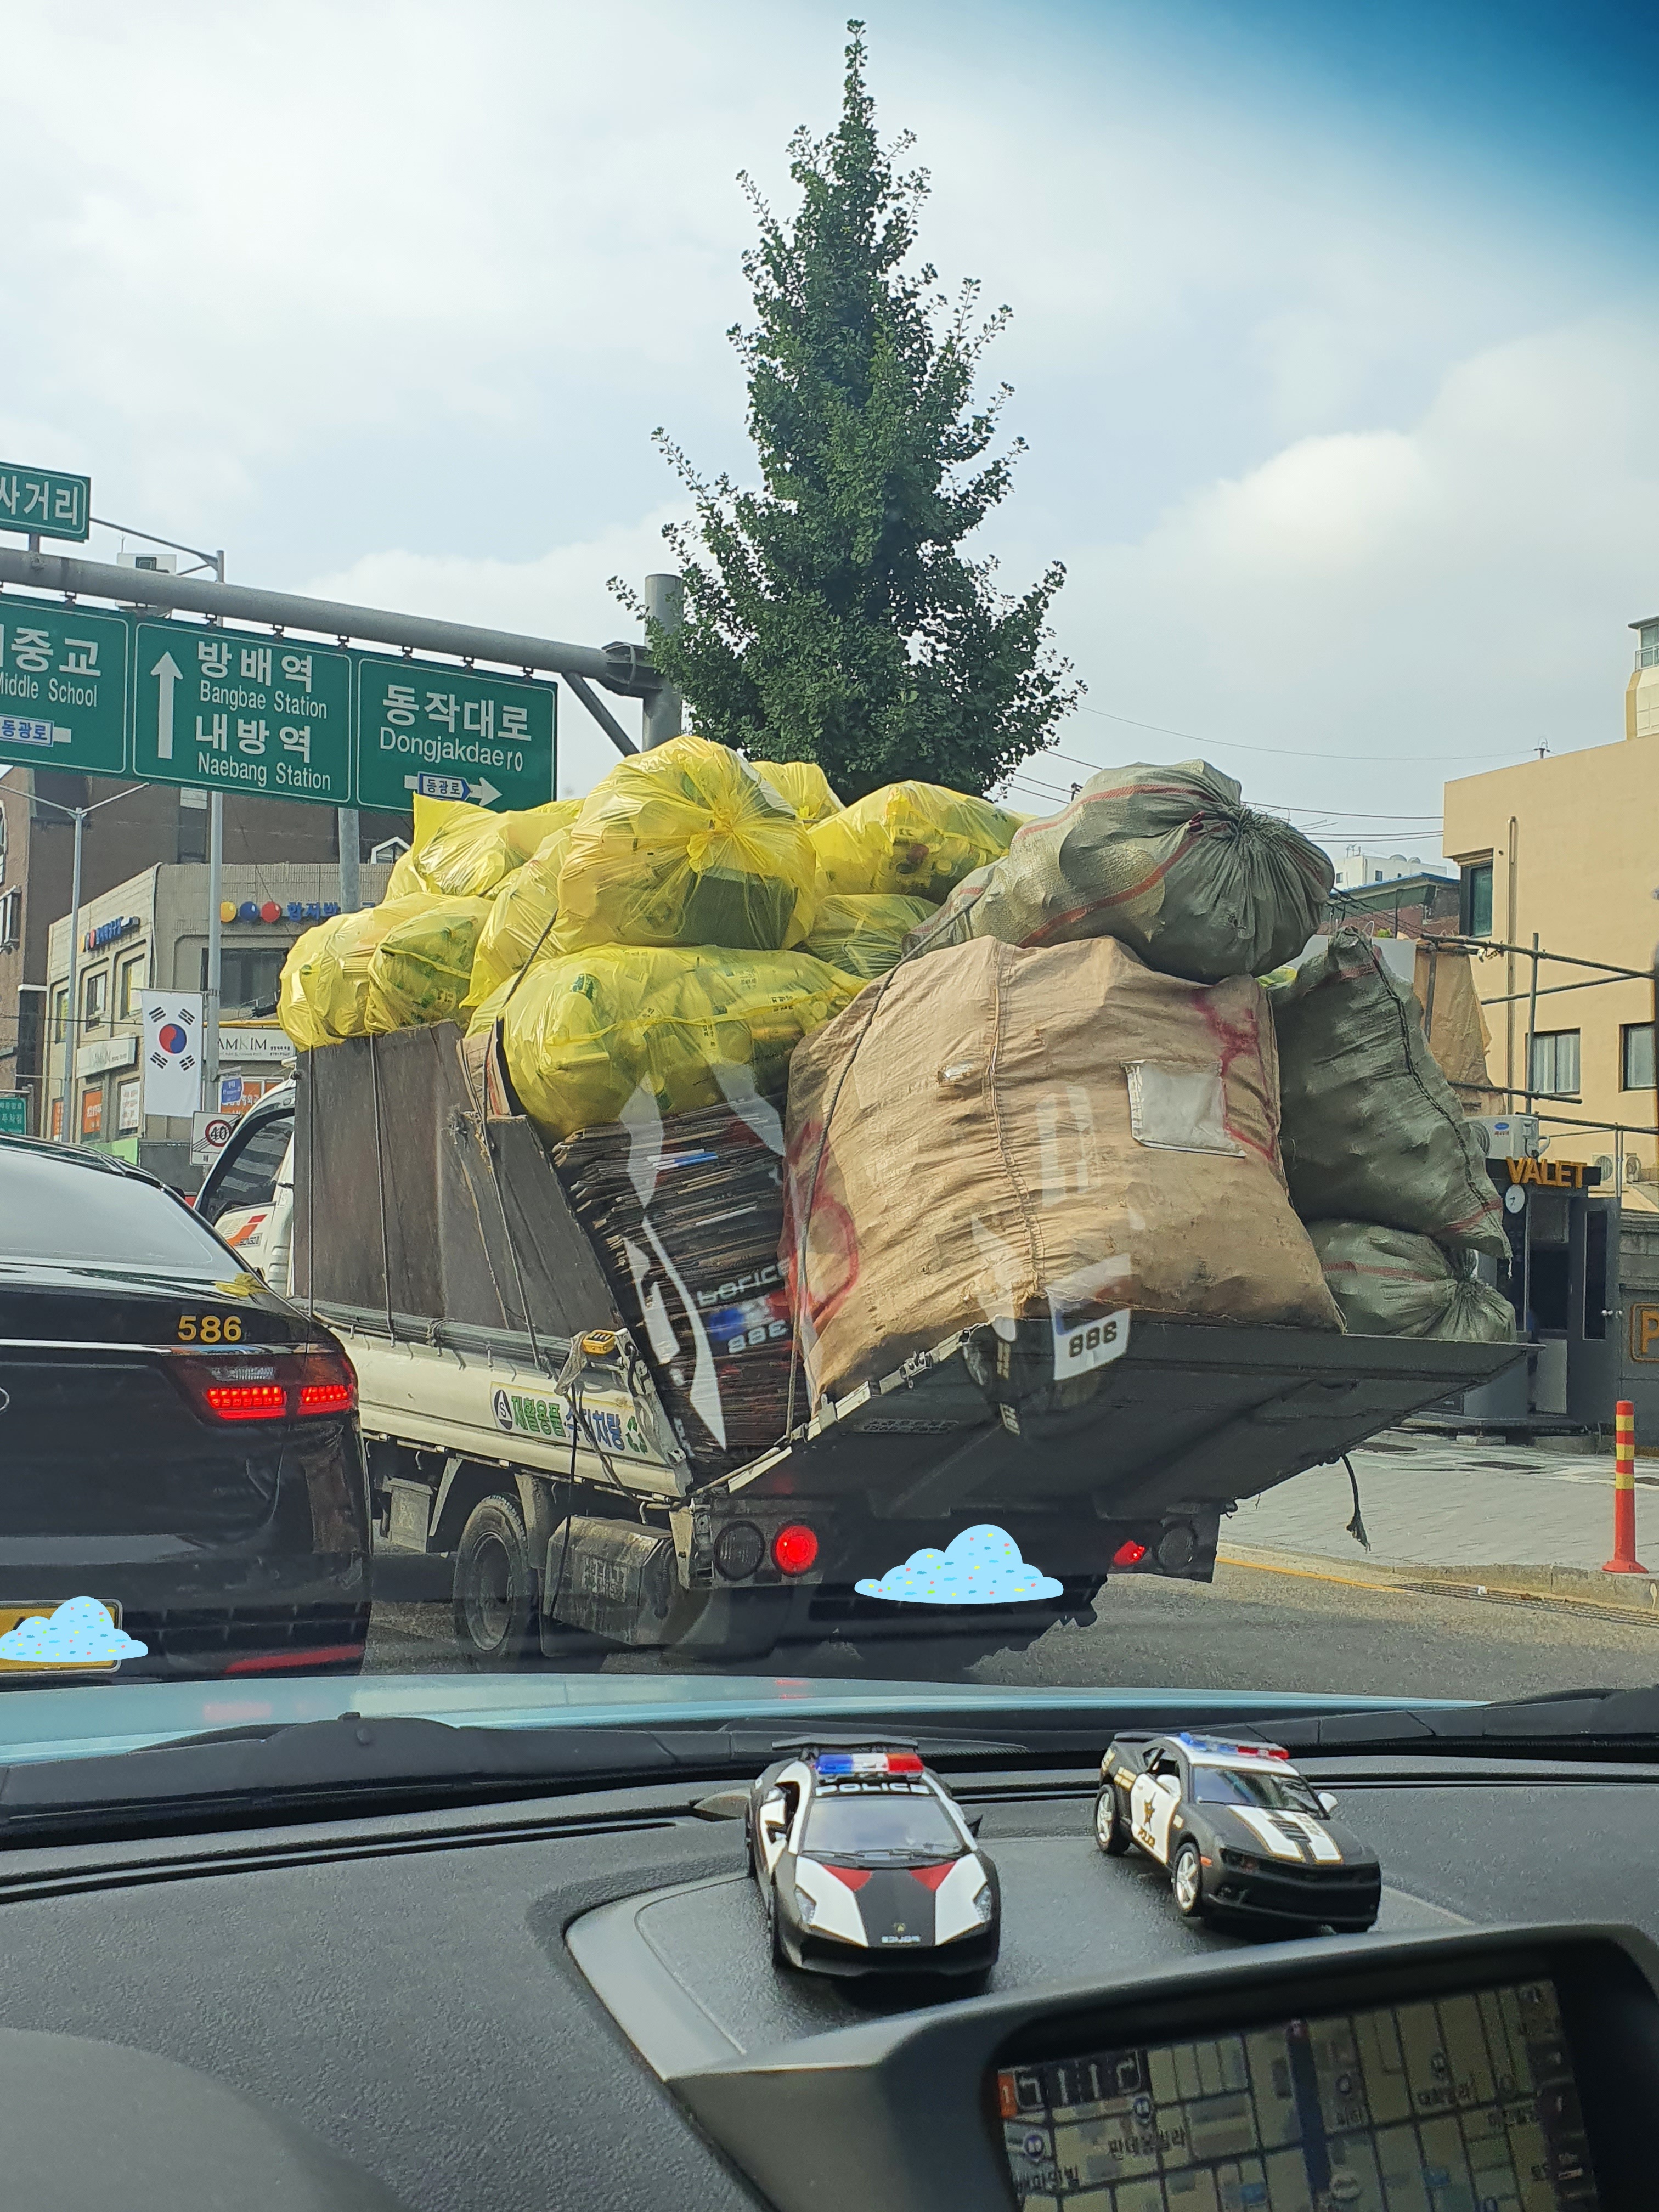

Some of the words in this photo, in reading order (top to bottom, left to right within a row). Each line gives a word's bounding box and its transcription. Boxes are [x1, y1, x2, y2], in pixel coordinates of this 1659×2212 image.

[0, 624, 101, 676] 중교
[198, 641, 312, 693] 방배역
[48, 678, 97, 707] School
[200, 679, 266, 712] Bangbae
[274, 690, 327, 719] Station
[383, 684, 532, 741] 동작대로
[2, 719, 47, 740] 동광로
[195, 714, 311, 763] 내방역
[380, 726, 523, 772] Dongjakdaero
[198, 751, 267, 787] Naebang
[276, 762, 331, 791] Station
[211, 1126, 227, 1141] 40
[1506, 1156, 1587, 1189] VALET
[178, 1315, 242, 1344] 586
[511, 1395, 566, 1438] 재활용품
[815, 1782, 930, 1797] POLICE
